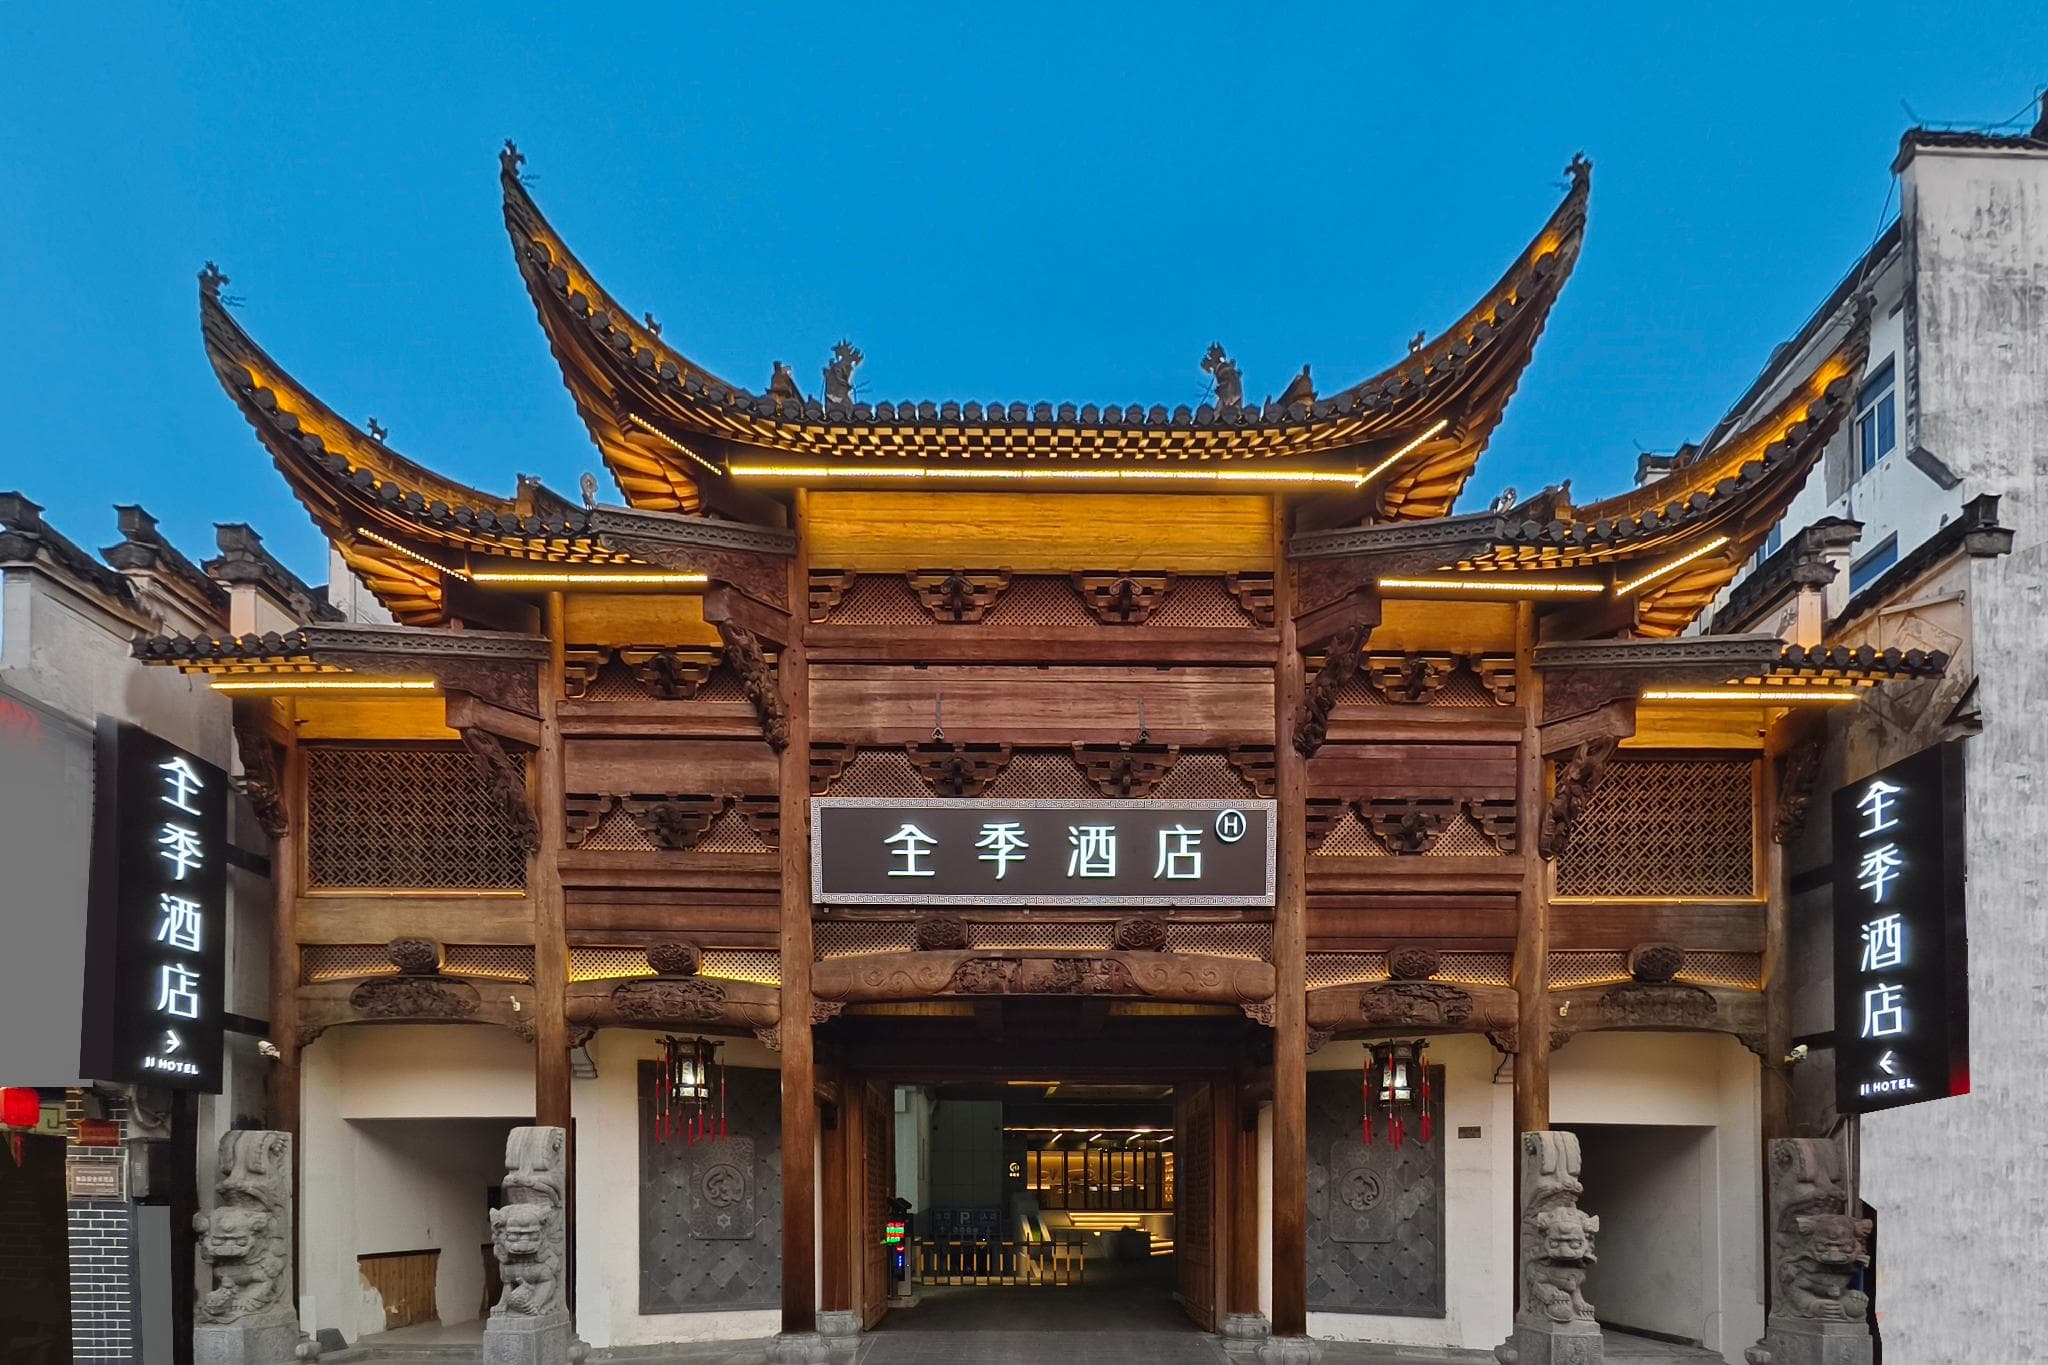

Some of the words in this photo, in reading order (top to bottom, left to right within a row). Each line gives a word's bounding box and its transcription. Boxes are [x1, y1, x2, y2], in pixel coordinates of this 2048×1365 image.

[884, 822, 1204, 879] 全季酒店
[157, 756, 204, 1019] 全季酒店
[1856, 780, 1903, 1039] 全季酒店
[158, 1058, 200, 1075] HOTEL
[1873, 1078, 1915, 1093] HOTEL
[959, 1211, 970, 1225] P
